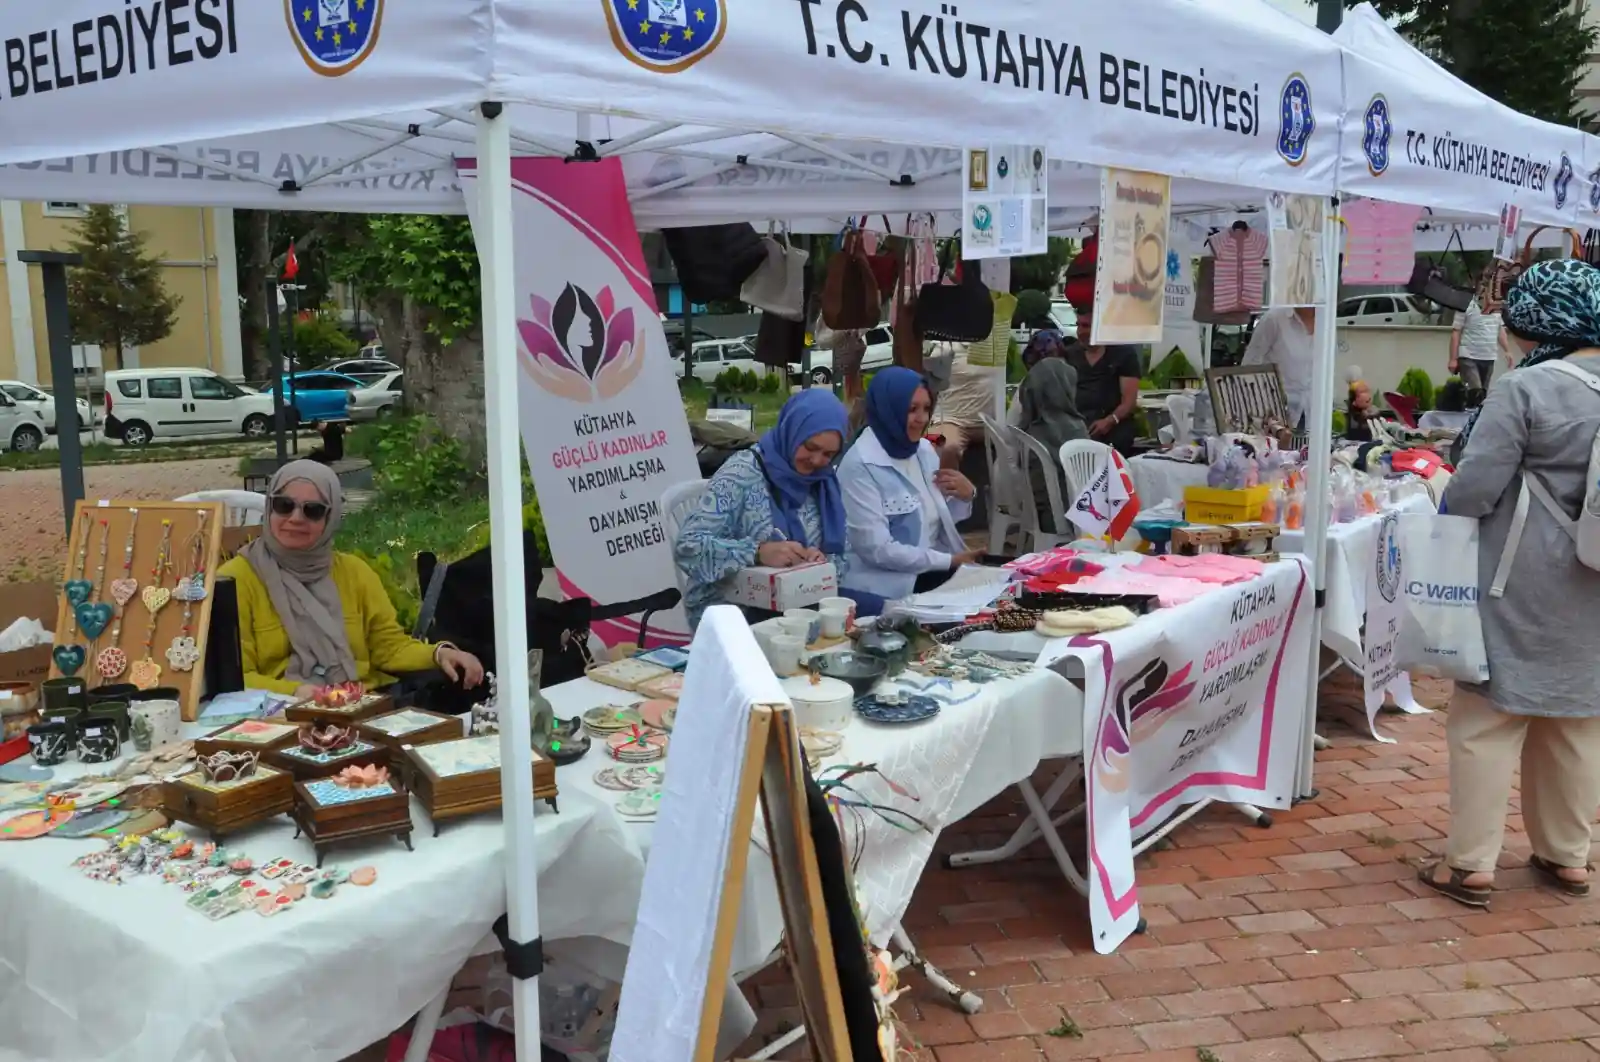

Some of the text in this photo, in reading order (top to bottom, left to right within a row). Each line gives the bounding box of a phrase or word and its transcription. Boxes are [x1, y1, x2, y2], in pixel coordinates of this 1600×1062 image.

[791, 0, 1259, 137] T.C. KÜTAHYA BELEDİYESİ
[1432, 130, 1488, 178] KÜTAHYA
[1490, 149, 1552, 194] BELEDİYESİ
[573, 409, 636, 437] KÜTAHYA
[551, 430, 669, 470] GÜÇLÜ KADINLAR
[567, 457, 666, 494] YARDIMLAŞMA
[618, 488, 628, 501] &
[588, 502, 662, 534] DAYANIŞM
[605, 522, 666, 557] DERNEĞİ
[1230, 583, 1276, 625] KÜTAHYA
